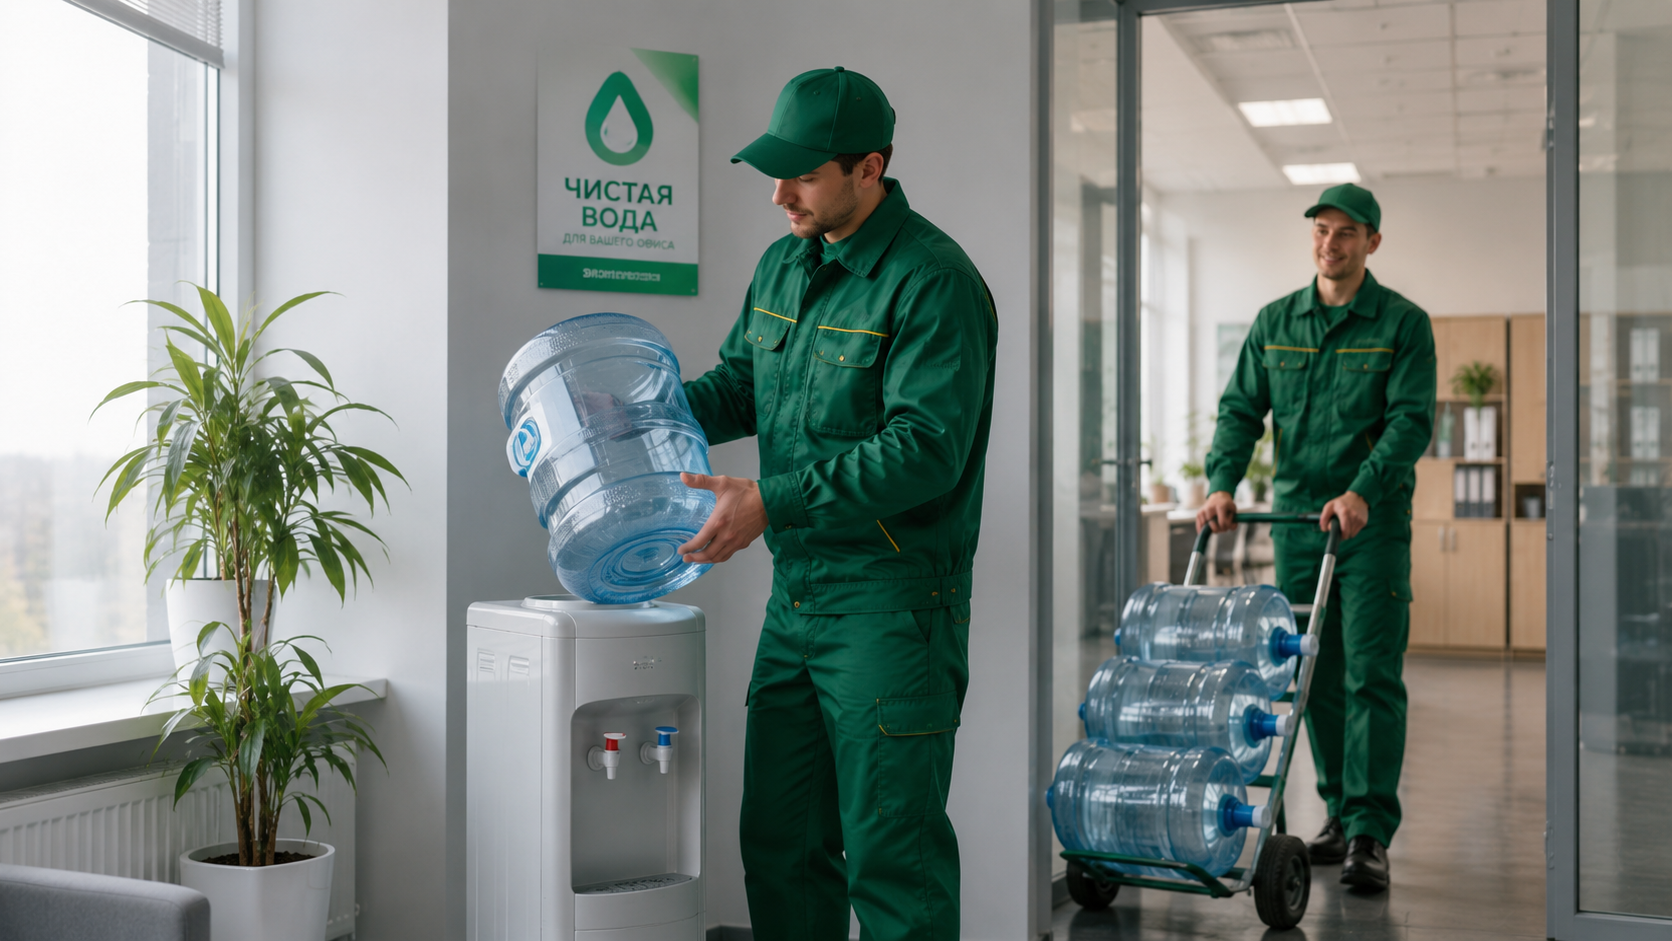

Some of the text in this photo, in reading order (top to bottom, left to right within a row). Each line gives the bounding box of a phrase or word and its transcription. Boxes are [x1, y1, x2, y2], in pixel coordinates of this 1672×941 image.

[564, 177, 673, 206] ЧИСТАЯ
[582, 206, 658, 234] ВОДА
[562, 233, 587, 245] ДЛЯ
[589, 235, 634, 247] ВАШЕГО
